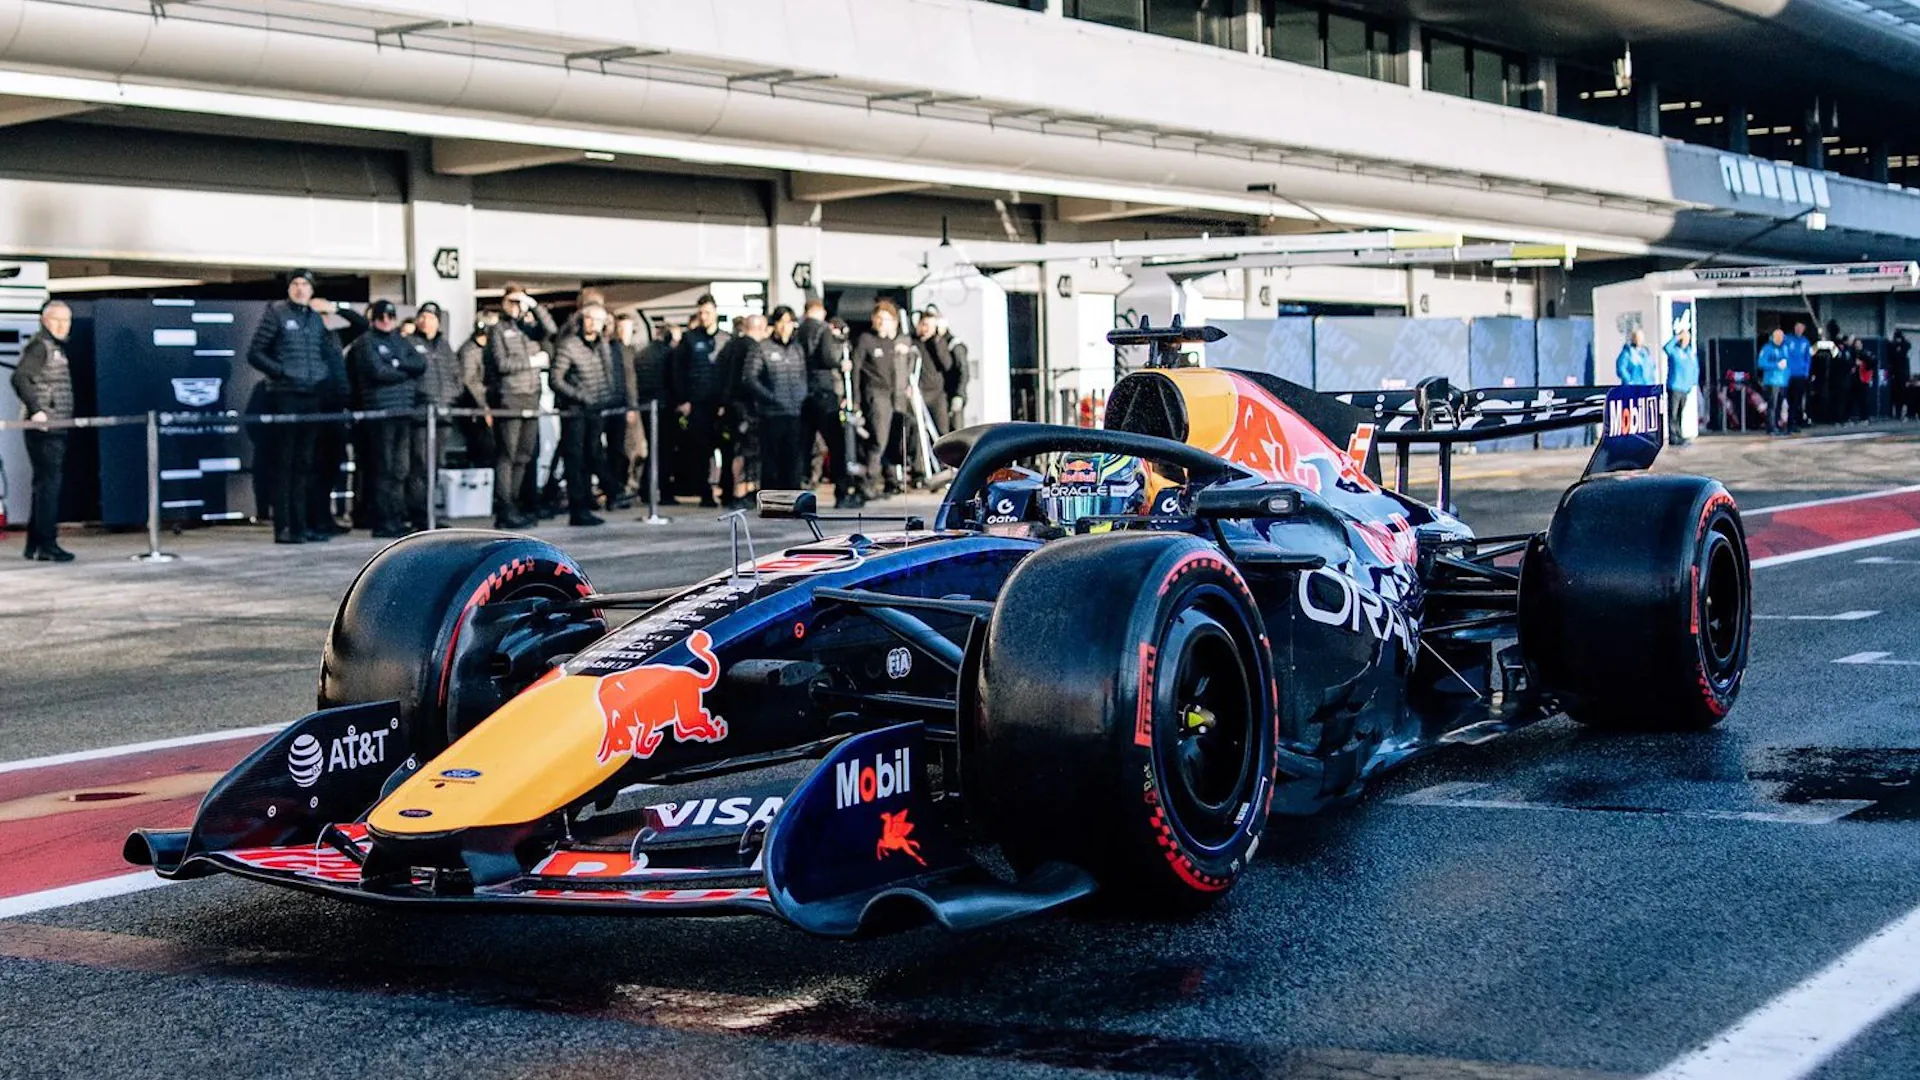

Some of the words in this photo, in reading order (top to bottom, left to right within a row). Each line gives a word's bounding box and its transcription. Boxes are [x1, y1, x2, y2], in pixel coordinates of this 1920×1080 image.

[437, 250, 458, 277] 46
[1609, 397, 1646, 437] Mobil
[1051, 485, 1108, 496] ORACLE
[328, 728, 389, 773] AT&T
[836, 747, 910, 809] Mobil
[645, 797, 786, 828] VISA
